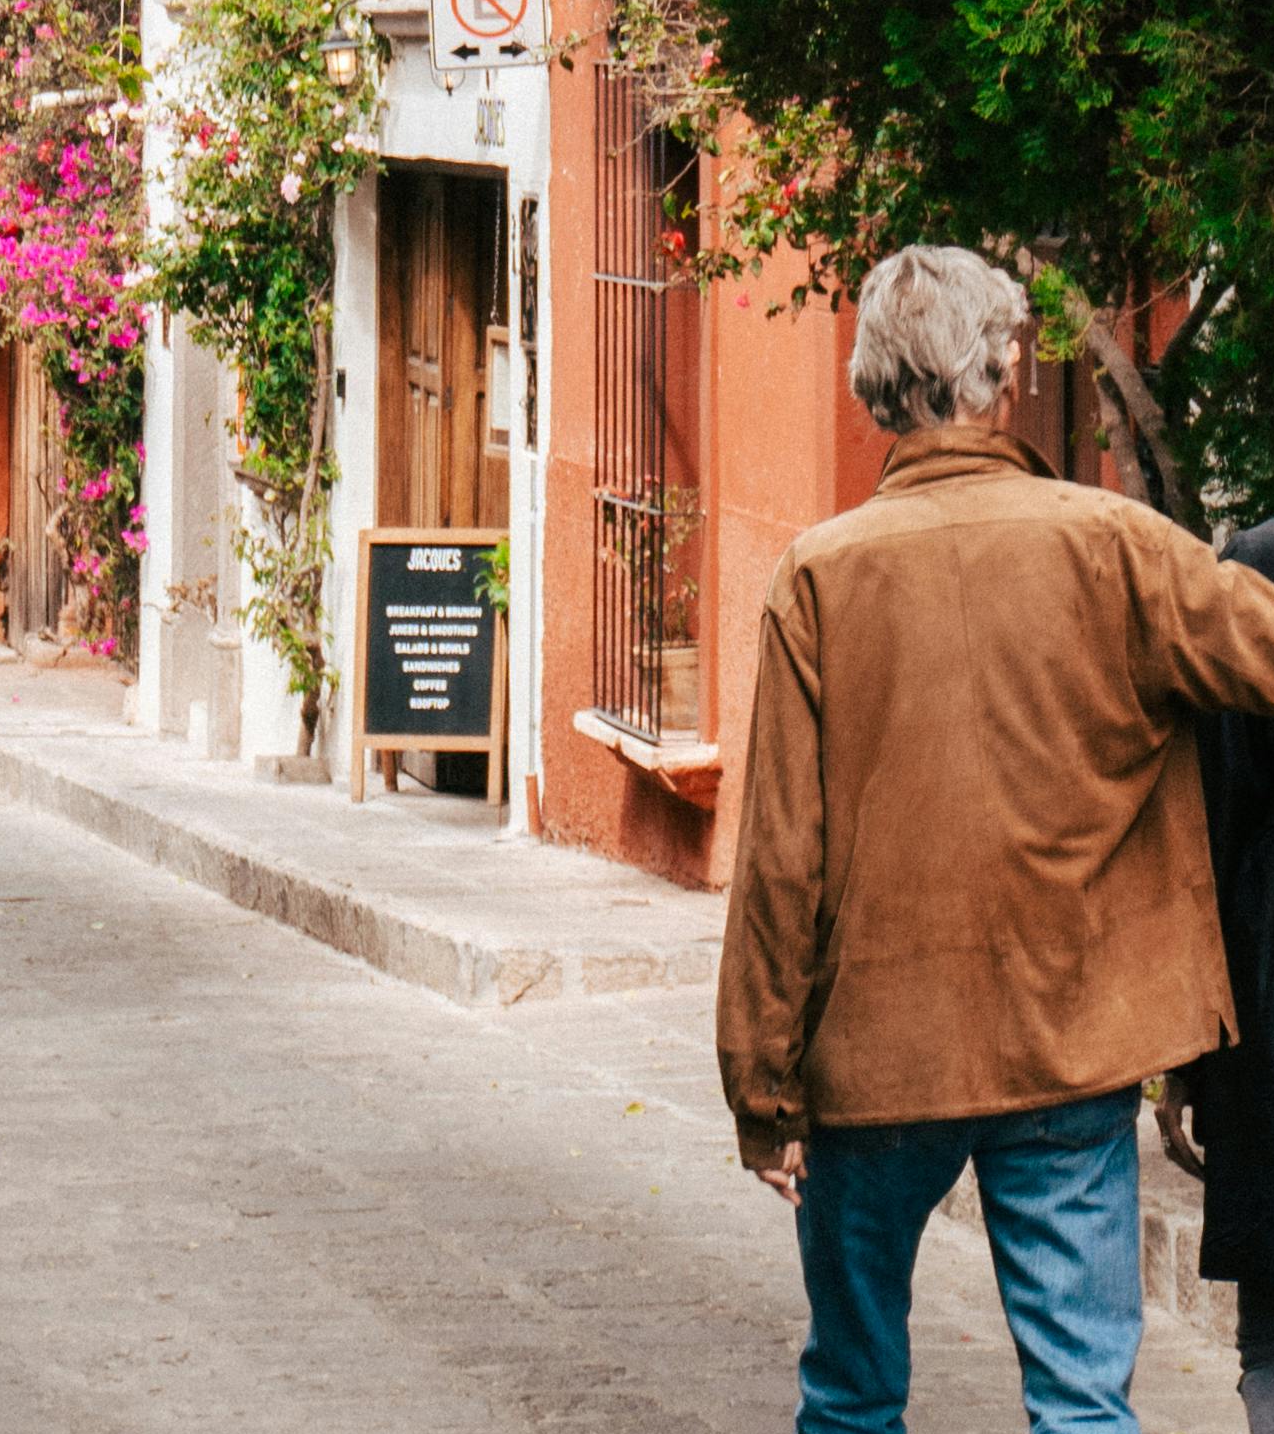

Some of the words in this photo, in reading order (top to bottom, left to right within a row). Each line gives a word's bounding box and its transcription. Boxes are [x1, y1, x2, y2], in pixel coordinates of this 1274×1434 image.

[407, 548, 462, 572] JACQUES
[386, 605, 436, 618] BREAKFAST
[445, 606, 482, 618] BRUNCH
[389, 624, 419, 636] JUICES
[428, 624, 478, 636] SMOOTHIES
[394, 642, 429, 654] SALADS
[438, 642, 470, 655] BOWLS
[402, 660, 460, 673] SANDWICHES
[413, 679, 447, 691] COFFEE
[409, 697, 450, 710] ROOFTOP
